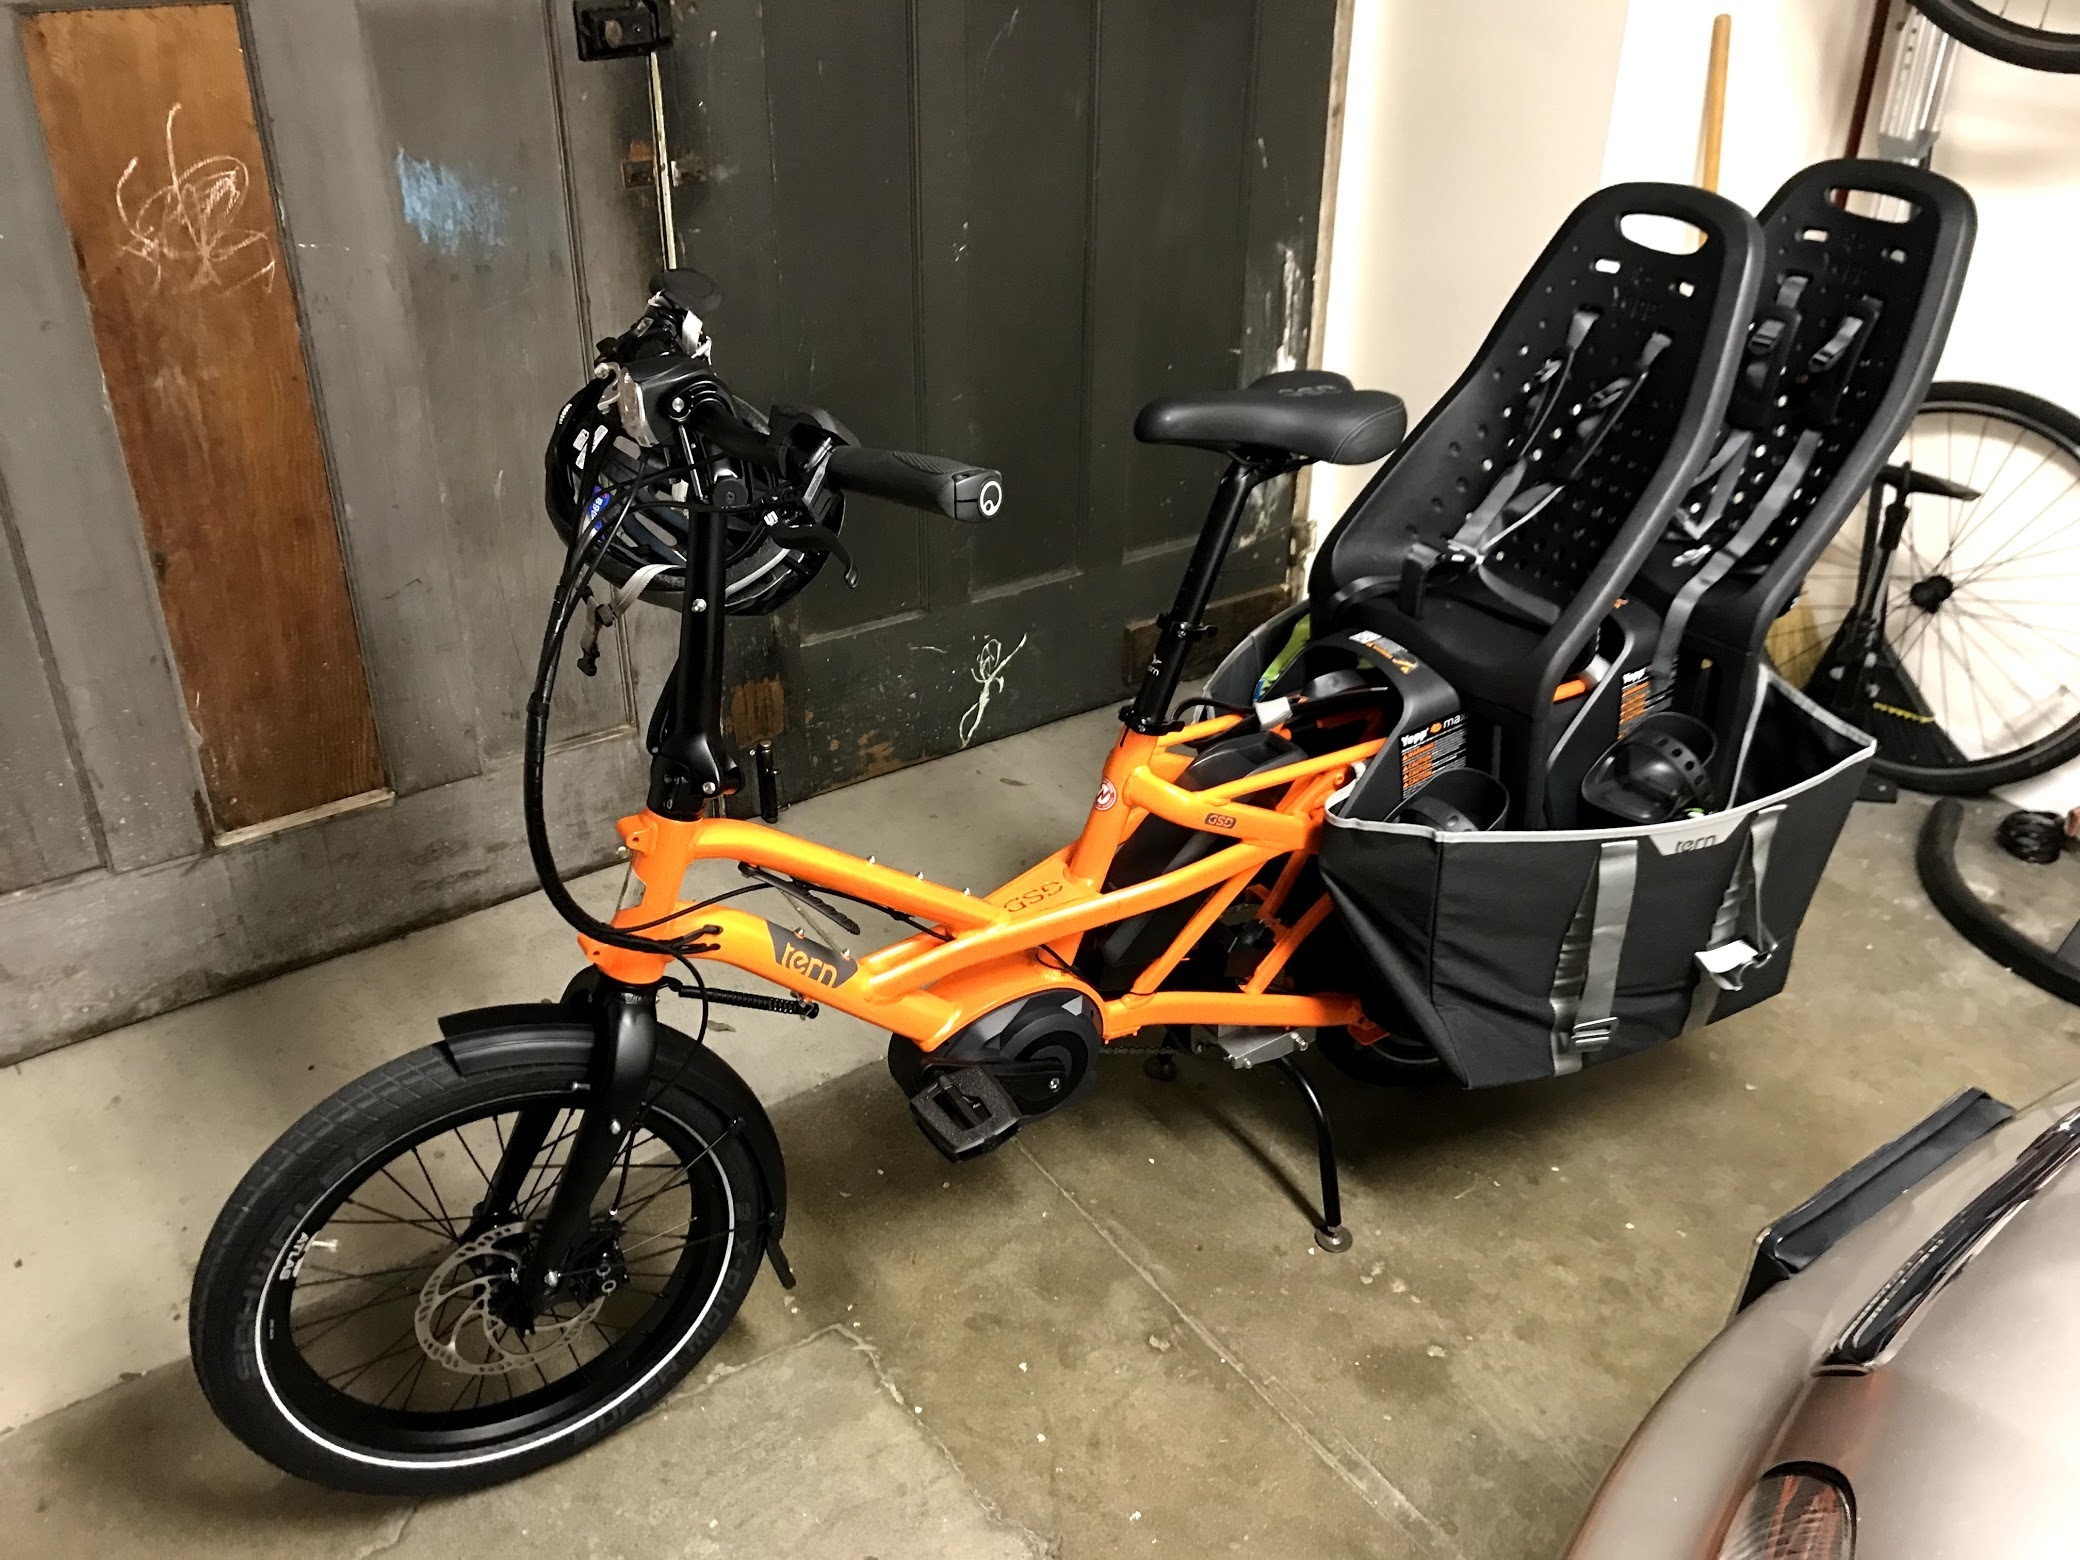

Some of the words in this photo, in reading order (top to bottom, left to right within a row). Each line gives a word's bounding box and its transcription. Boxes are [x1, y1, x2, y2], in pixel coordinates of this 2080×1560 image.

[1401, 727, 1430, 747] Yepp
[1208, 814, 1234, 828] GSD
[1003, 881, 1063, 912] GSD
[781, 941, 838, 988] tern
[279, 1231, 310, 1281] ATLAS
